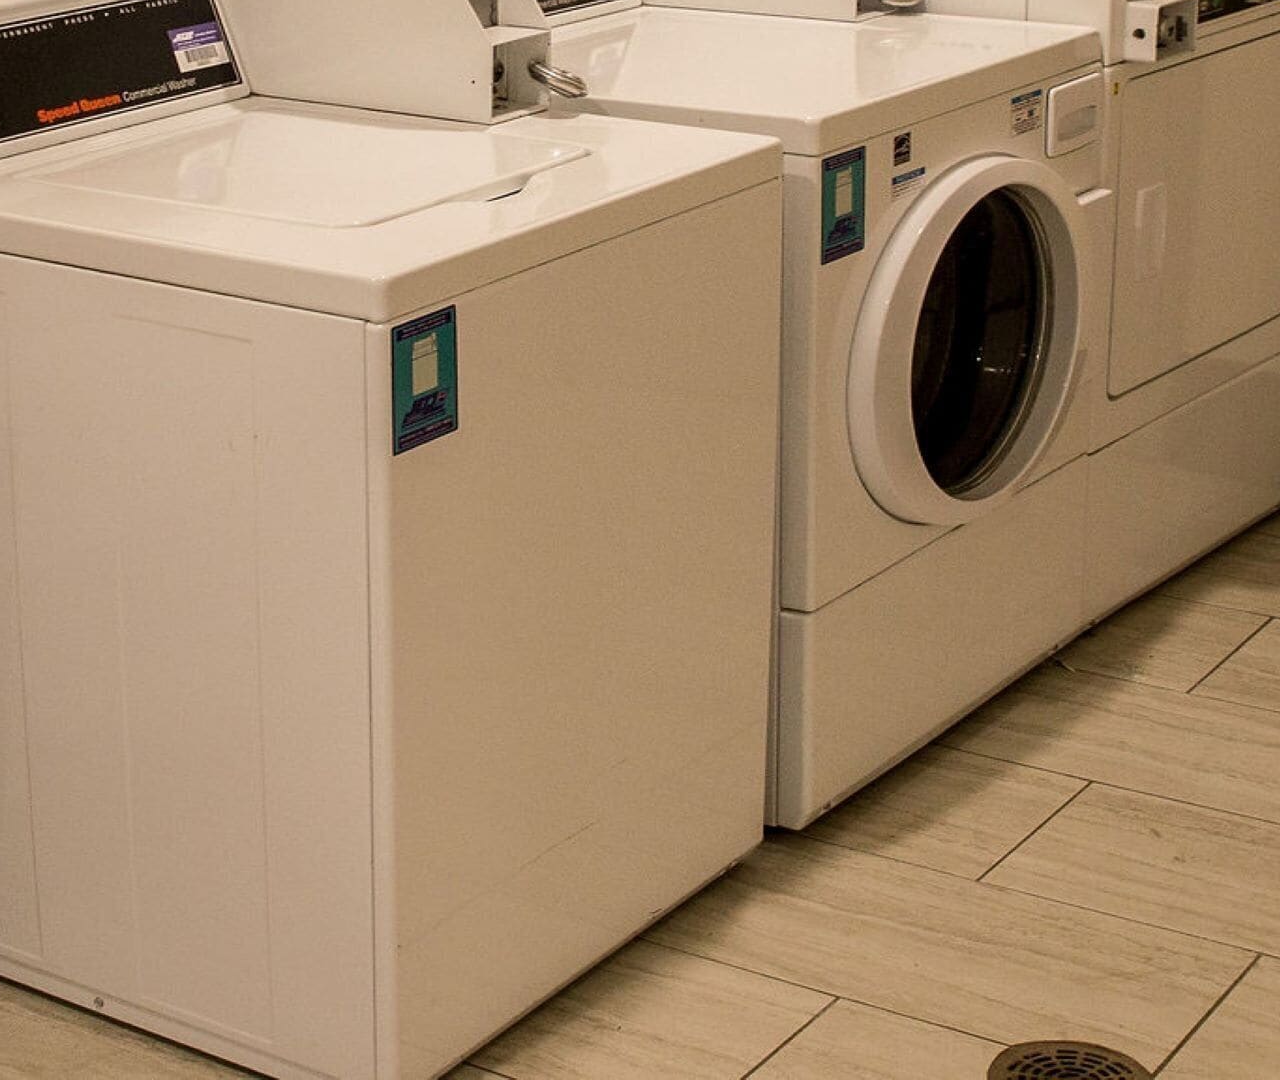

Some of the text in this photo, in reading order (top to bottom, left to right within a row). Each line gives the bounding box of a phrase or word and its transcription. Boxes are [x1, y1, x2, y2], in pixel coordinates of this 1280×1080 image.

[64, 13, 95, 26] PRESS
[119, 6, 136, 15] ALL
[36, 76, 197, 124] Speed Queen Commercial Washer
